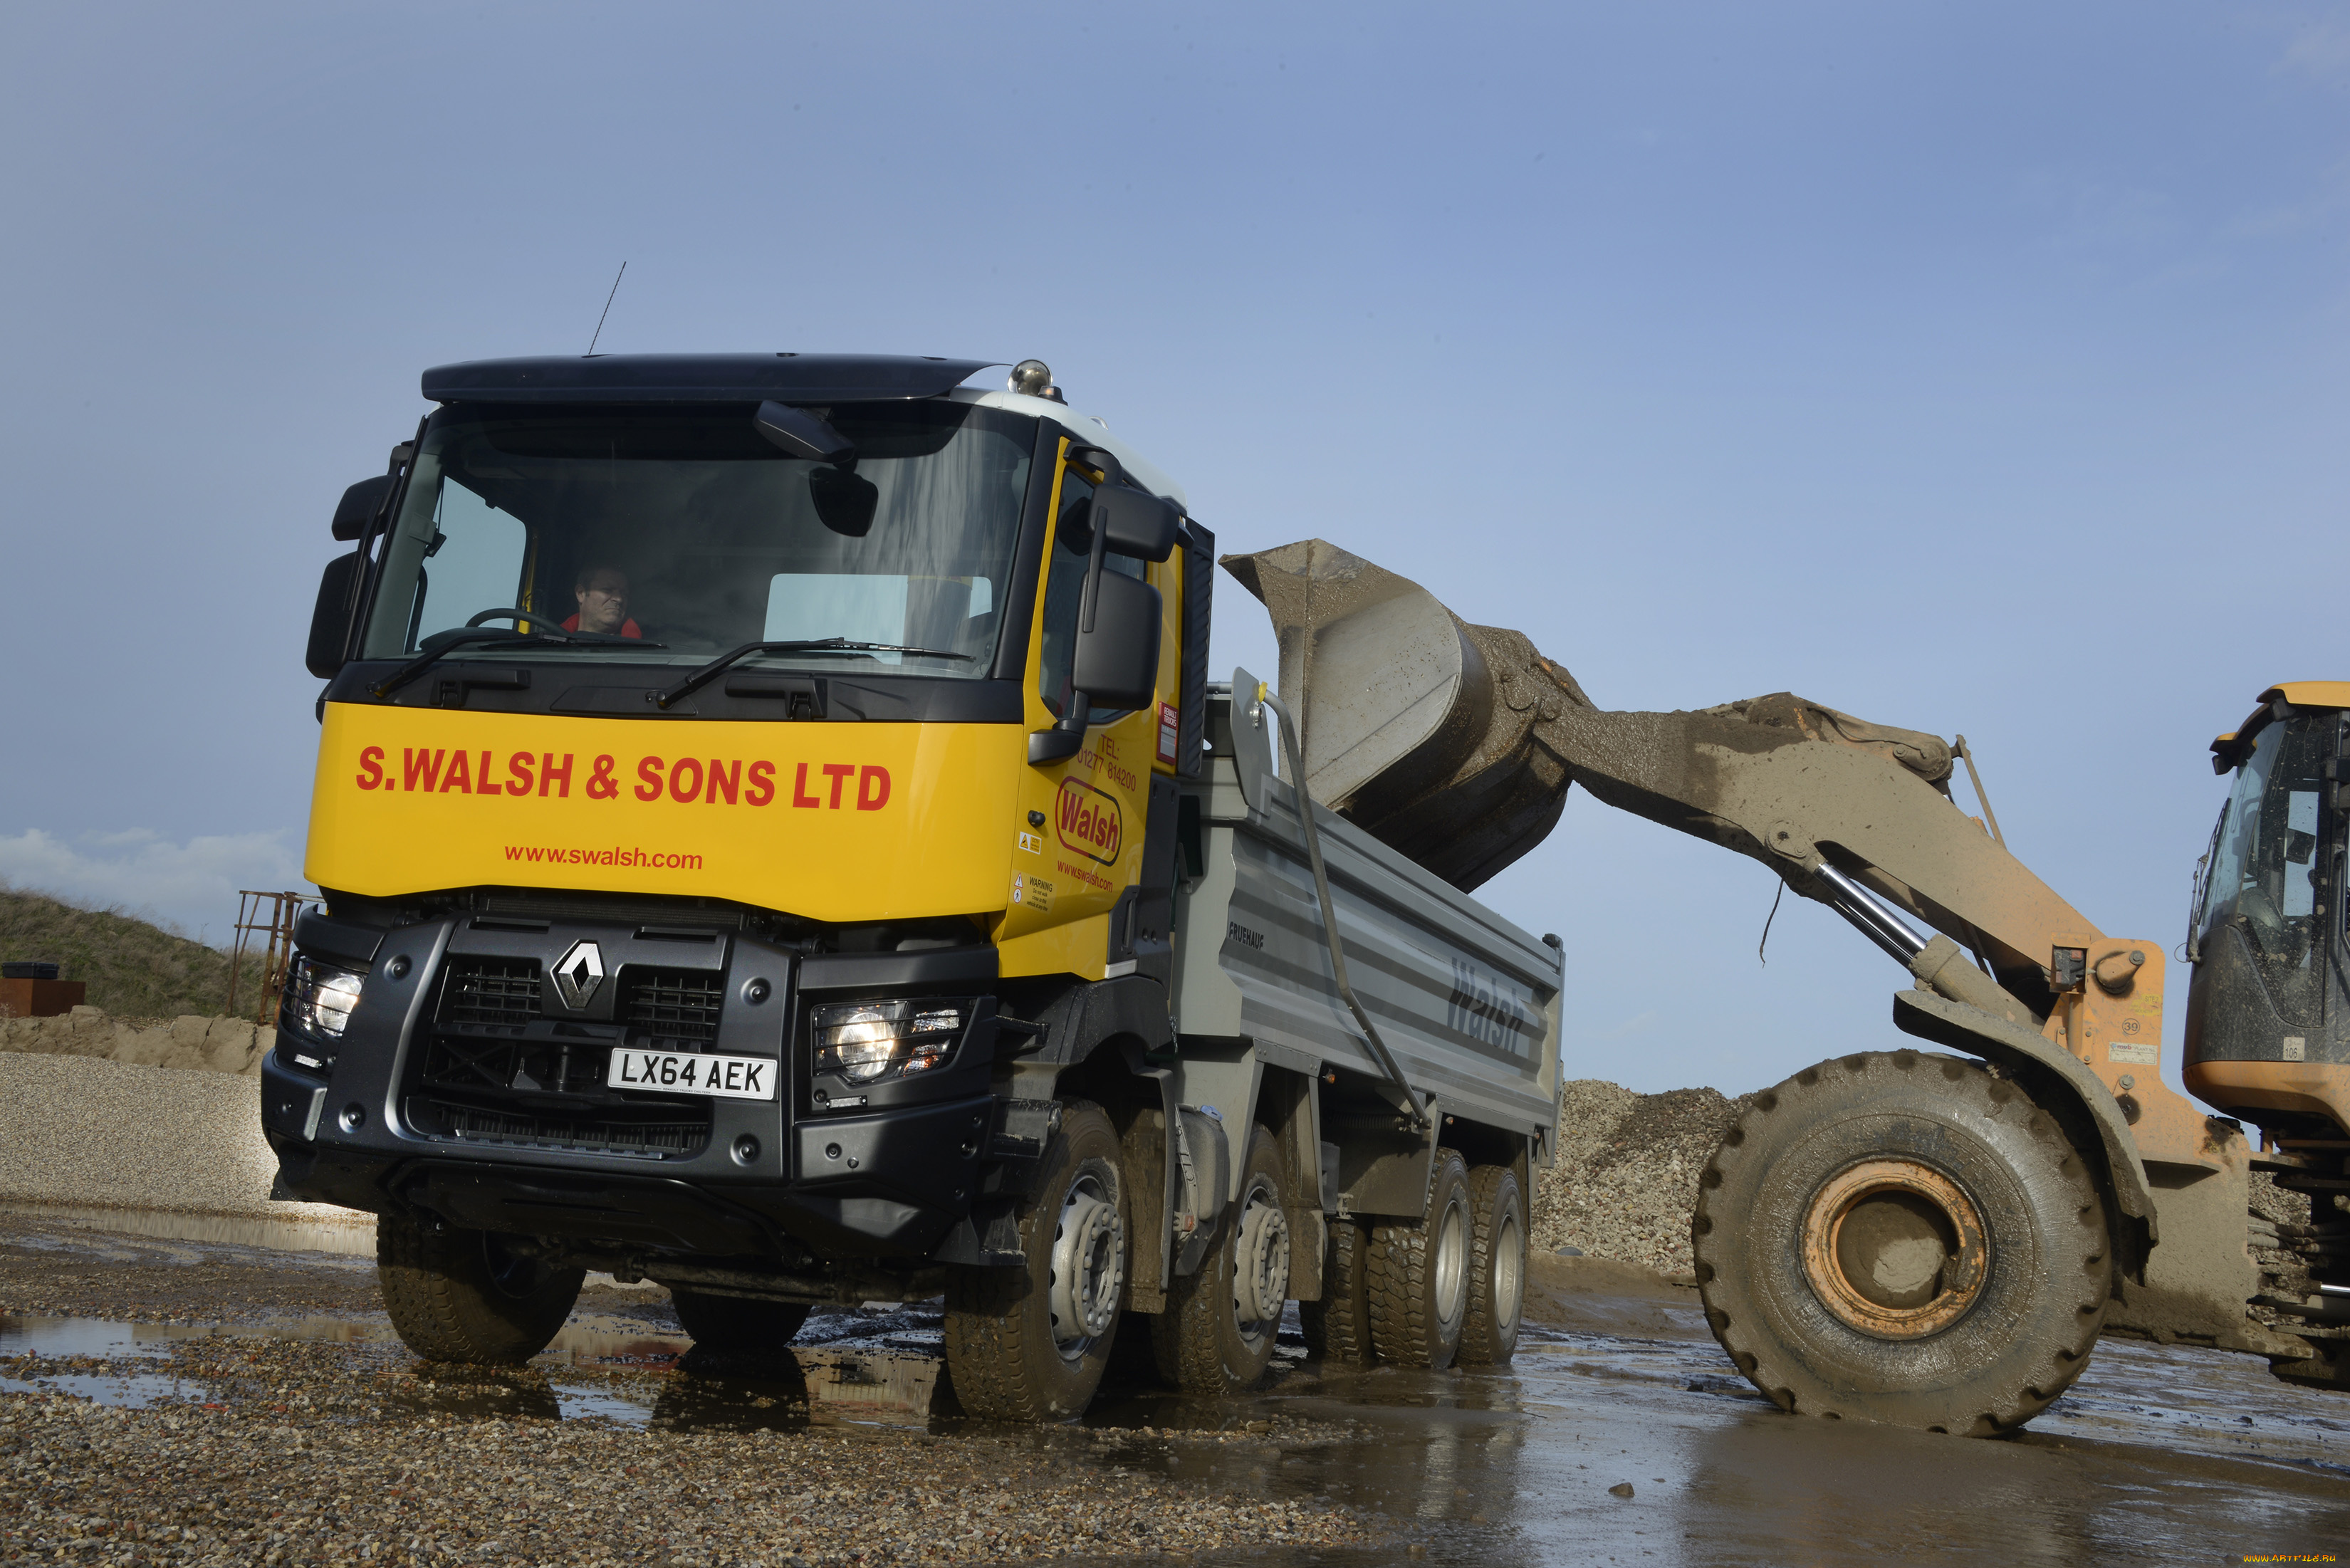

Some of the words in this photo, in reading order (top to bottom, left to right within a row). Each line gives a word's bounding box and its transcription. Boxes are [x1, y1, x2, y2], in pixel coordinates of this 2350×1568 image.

[1164, 715, 1176, 727] TRUCKS
[1101, 733, 1119, 761] TEL:
[586, 754, 620, 800] &
[634, 756, 776, 807] SONS
[793, 763, 891, 811] LTD
[1077, 747, 1104, 773] 01277
[1107, 762, 1137, 792] 814200
[1061, 789, 1118, 852] Walsh
[505, 846, 702, 869] www.swalsh.com
[1030, 876, 1053, 892] WARNING
[1058, 860, 1113, 892] www.swalsh.com
[1229, 921, 1264, 951] FRUEHAUF
[1447, 957, 1524, 1054] Walsh
[2124, 1022, 2138, 1032] 39
[2285, 1047, 2297, 1059] 106
[621, 1053, 696, 1087] LX64
[706, 1060, 763, 1092] AEK
